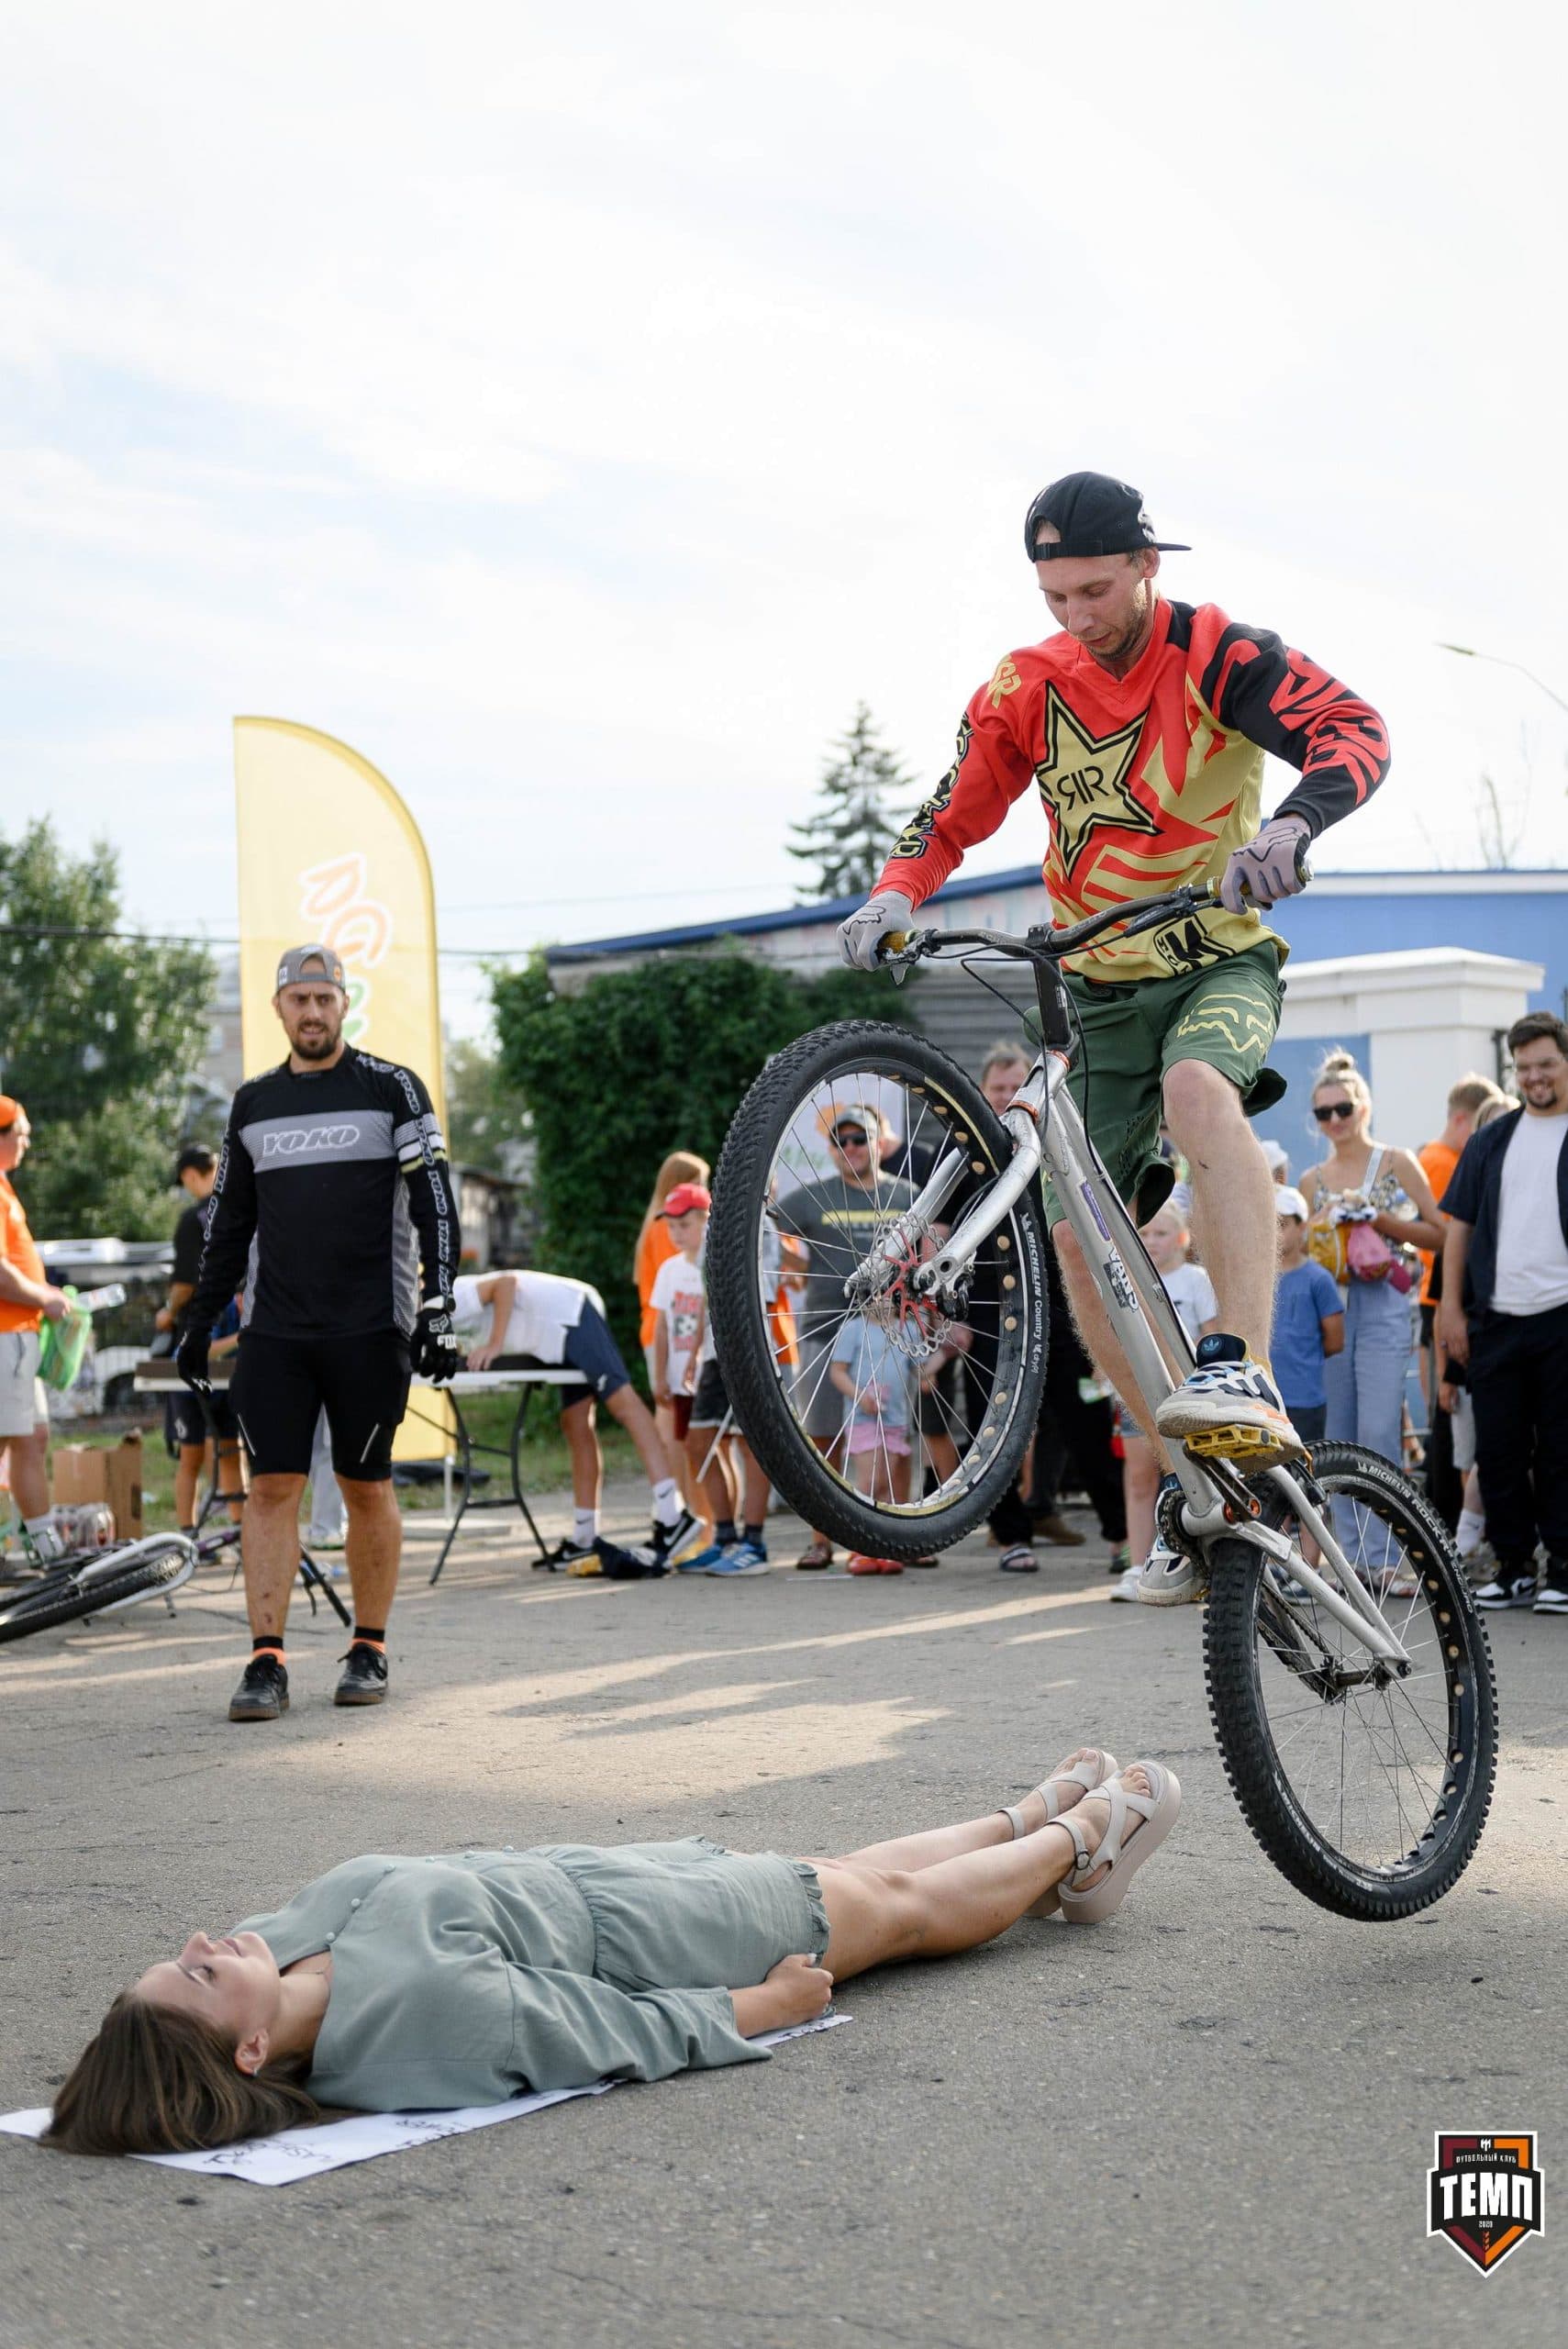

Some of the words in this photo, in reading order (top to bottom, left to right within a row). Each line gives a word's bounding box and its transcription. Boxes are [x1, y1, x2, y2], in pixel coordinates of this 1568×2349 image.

[262, 1123, 361, 1158] YOKO
[1026, 1230, 1043, 1297] MICHELIN
[1033, 1299, 1044, 1341] Country
[1369, 1464, 1412, 1499] MICHELIN
